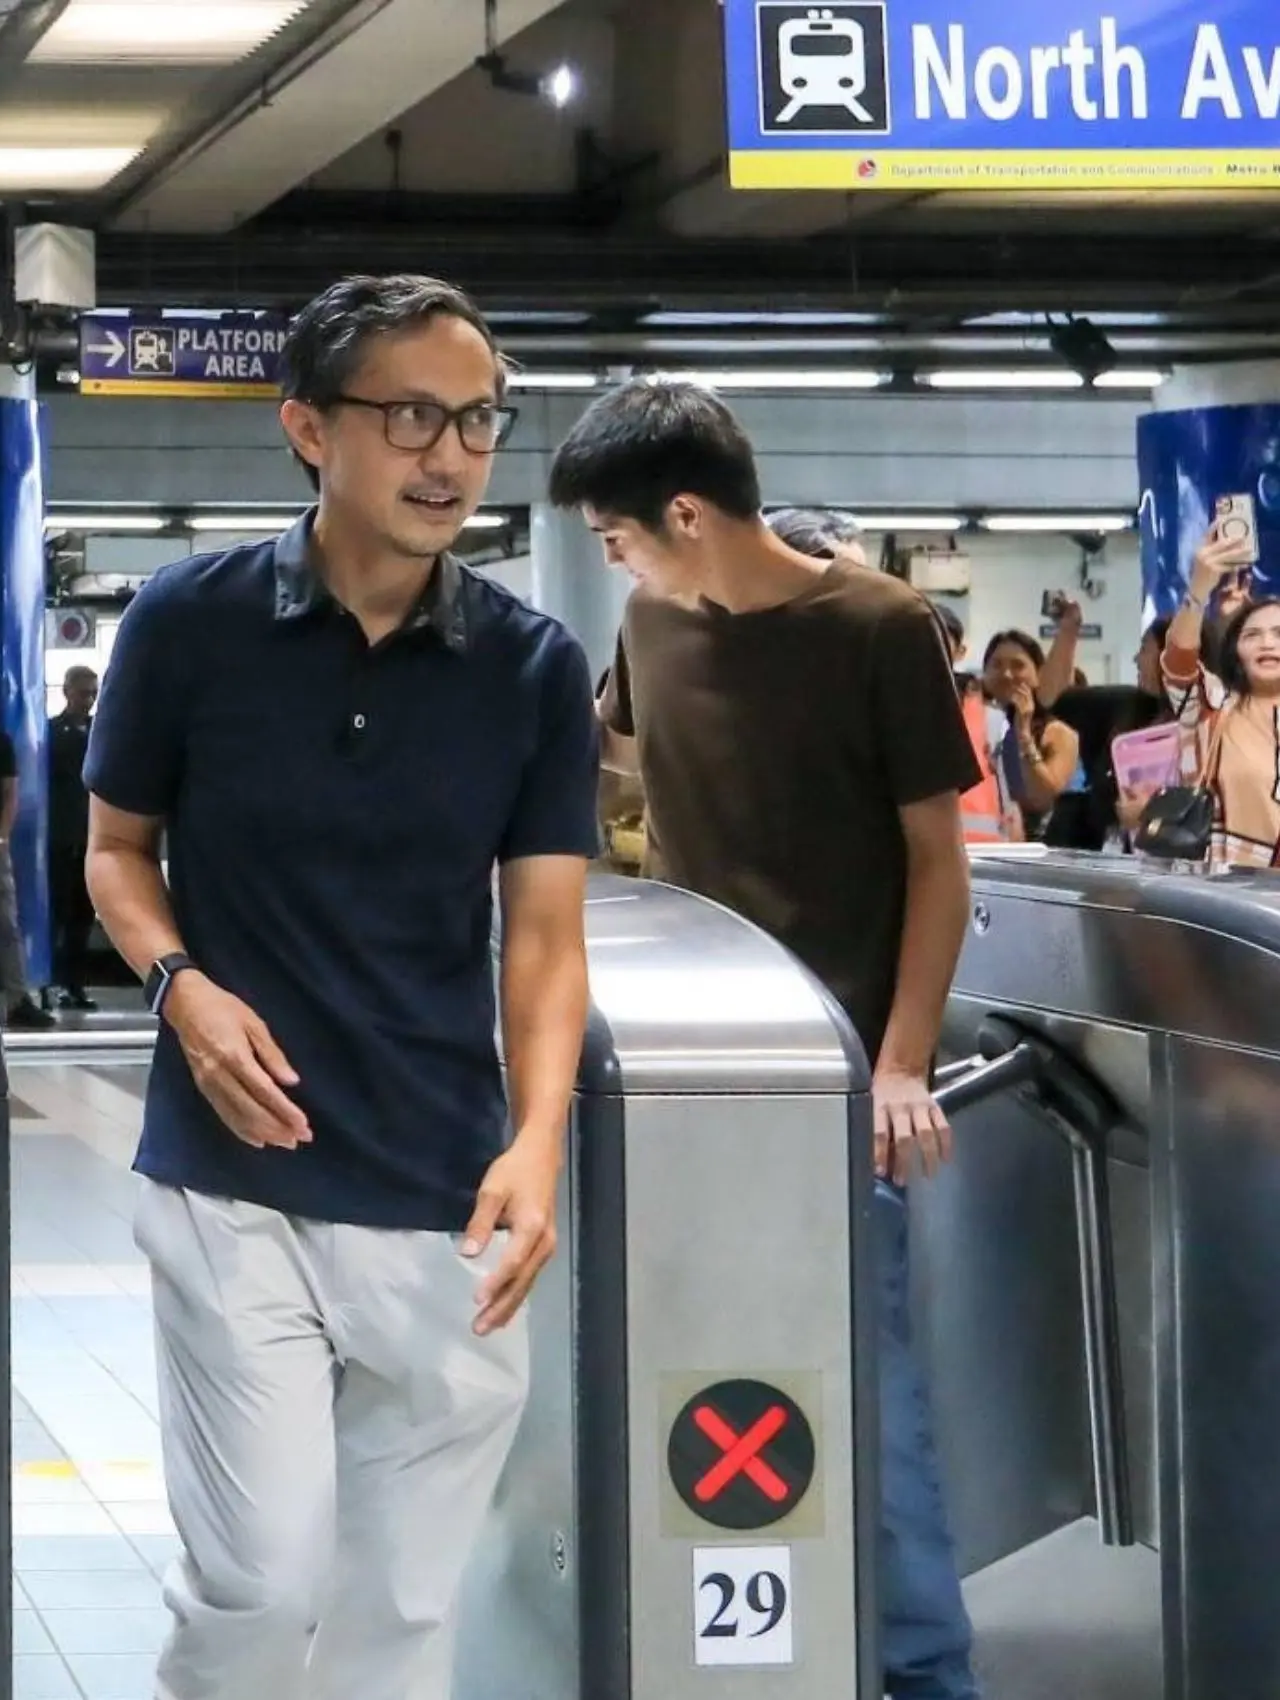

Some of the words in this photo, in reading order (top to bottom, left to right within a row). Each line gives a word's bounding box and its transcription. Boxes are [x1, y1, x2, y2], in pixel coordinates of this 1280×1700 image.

[912, 16, 1148, 121] North
[1180, 23, 1280, 120] Av
[204, 354, 266, 377] AREA
[699, 1570, 786, 1638] 29
